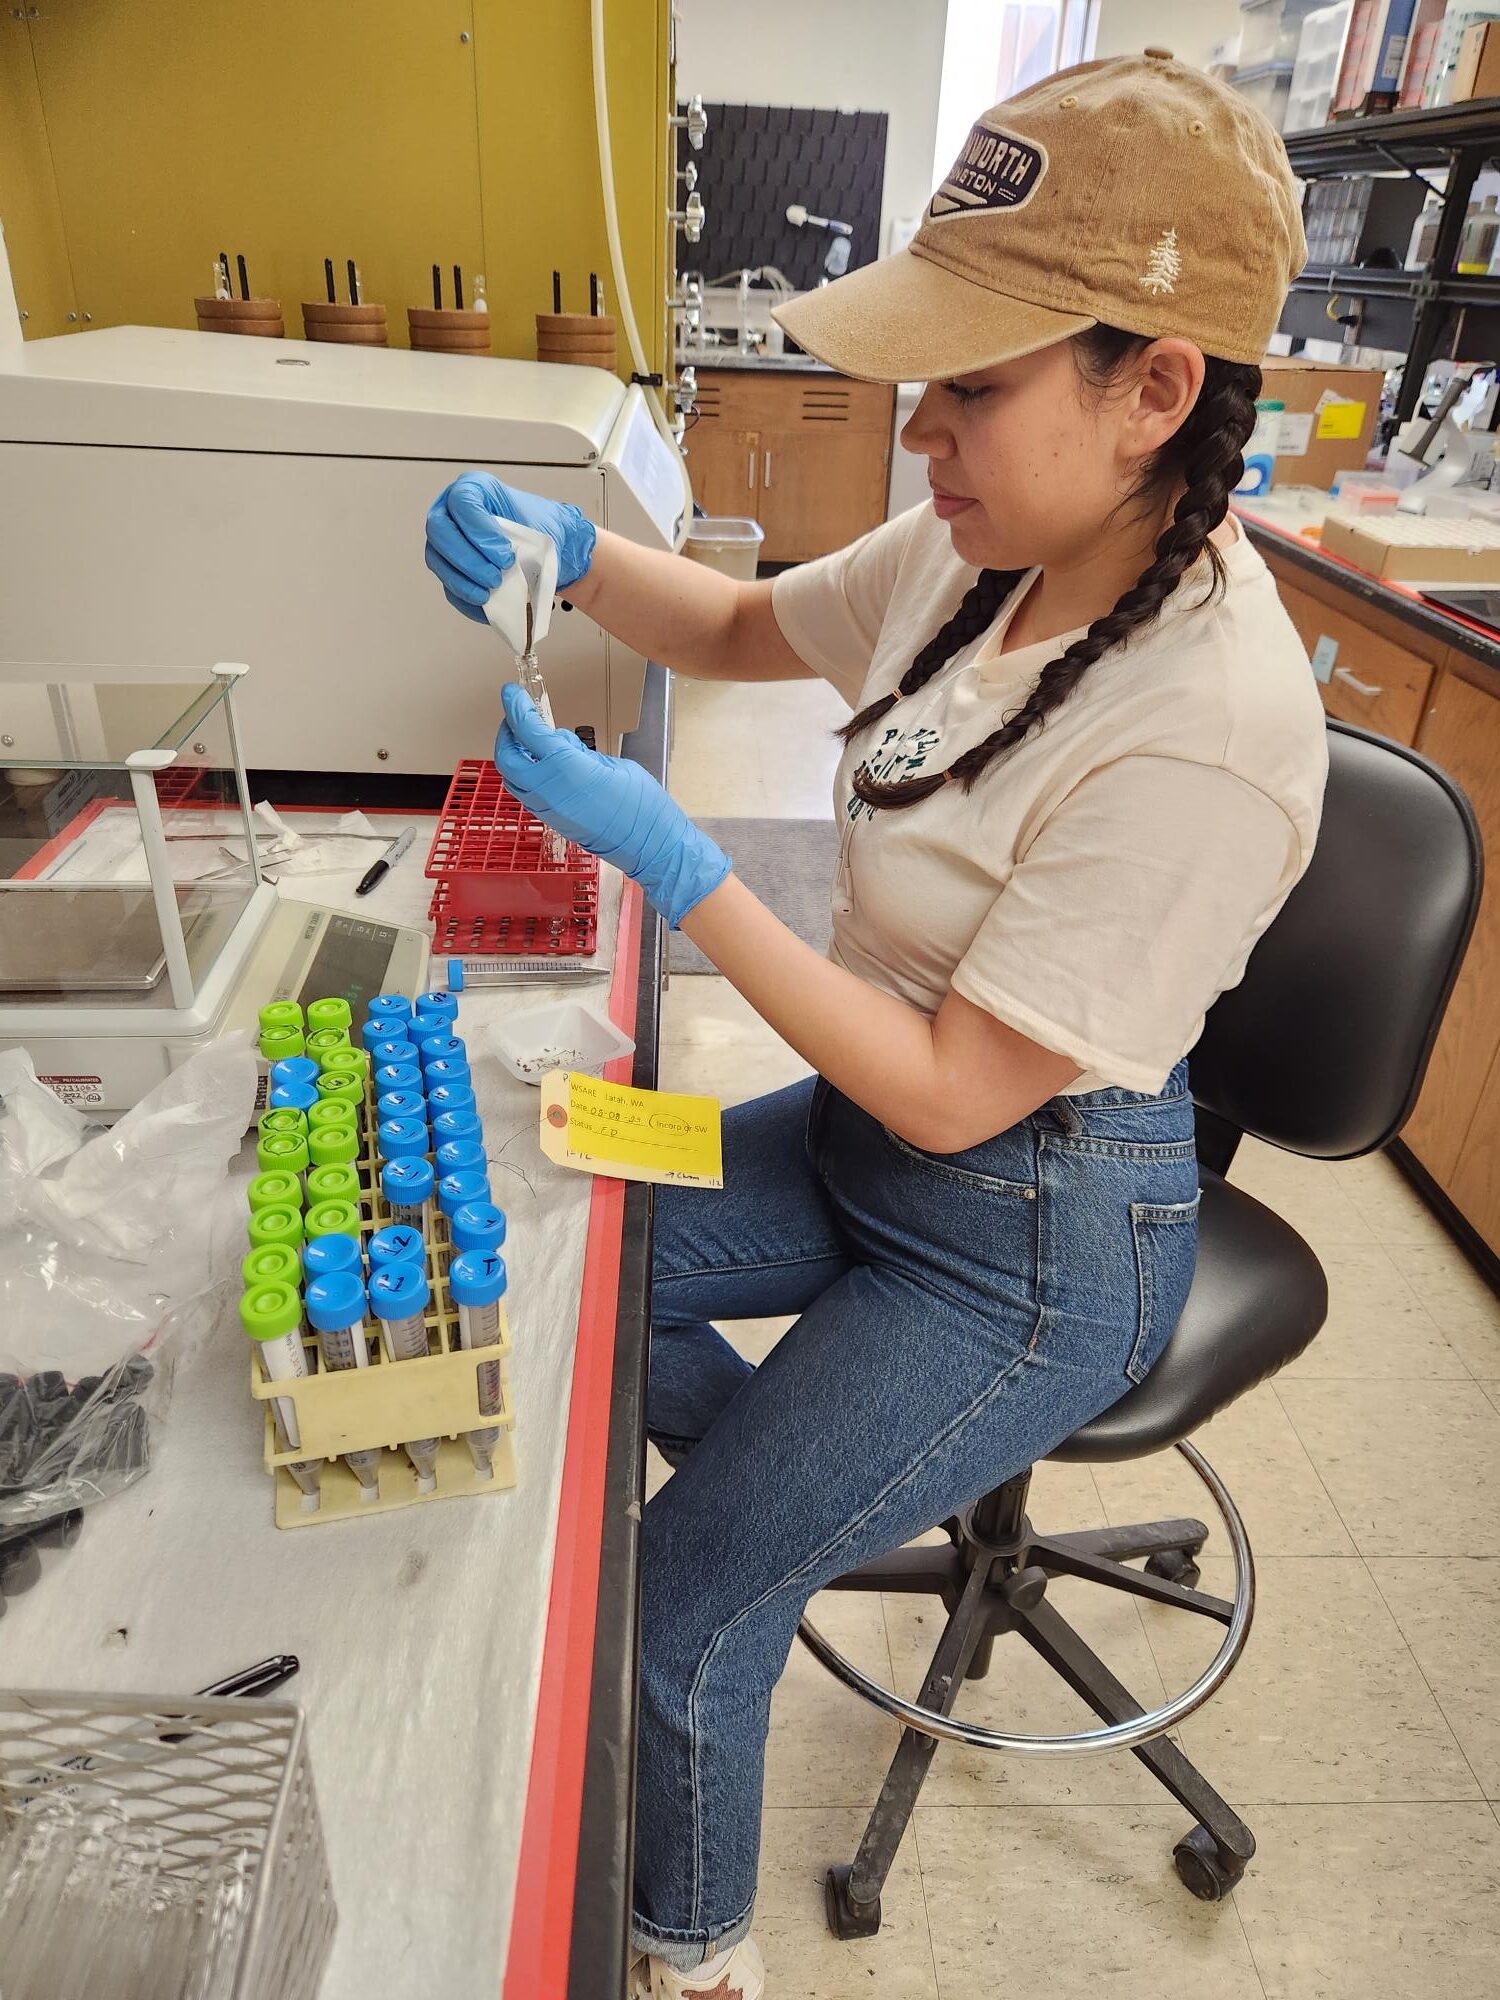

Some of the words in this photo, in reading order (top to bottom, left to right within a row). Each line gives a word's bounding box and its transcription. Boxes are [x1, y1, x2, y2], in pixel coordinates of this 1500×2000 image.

[963, 132, 1033, 186] WORTH
[570, 1099, 588, 1112] Date
[630, 1098, 645, 1109] WA
